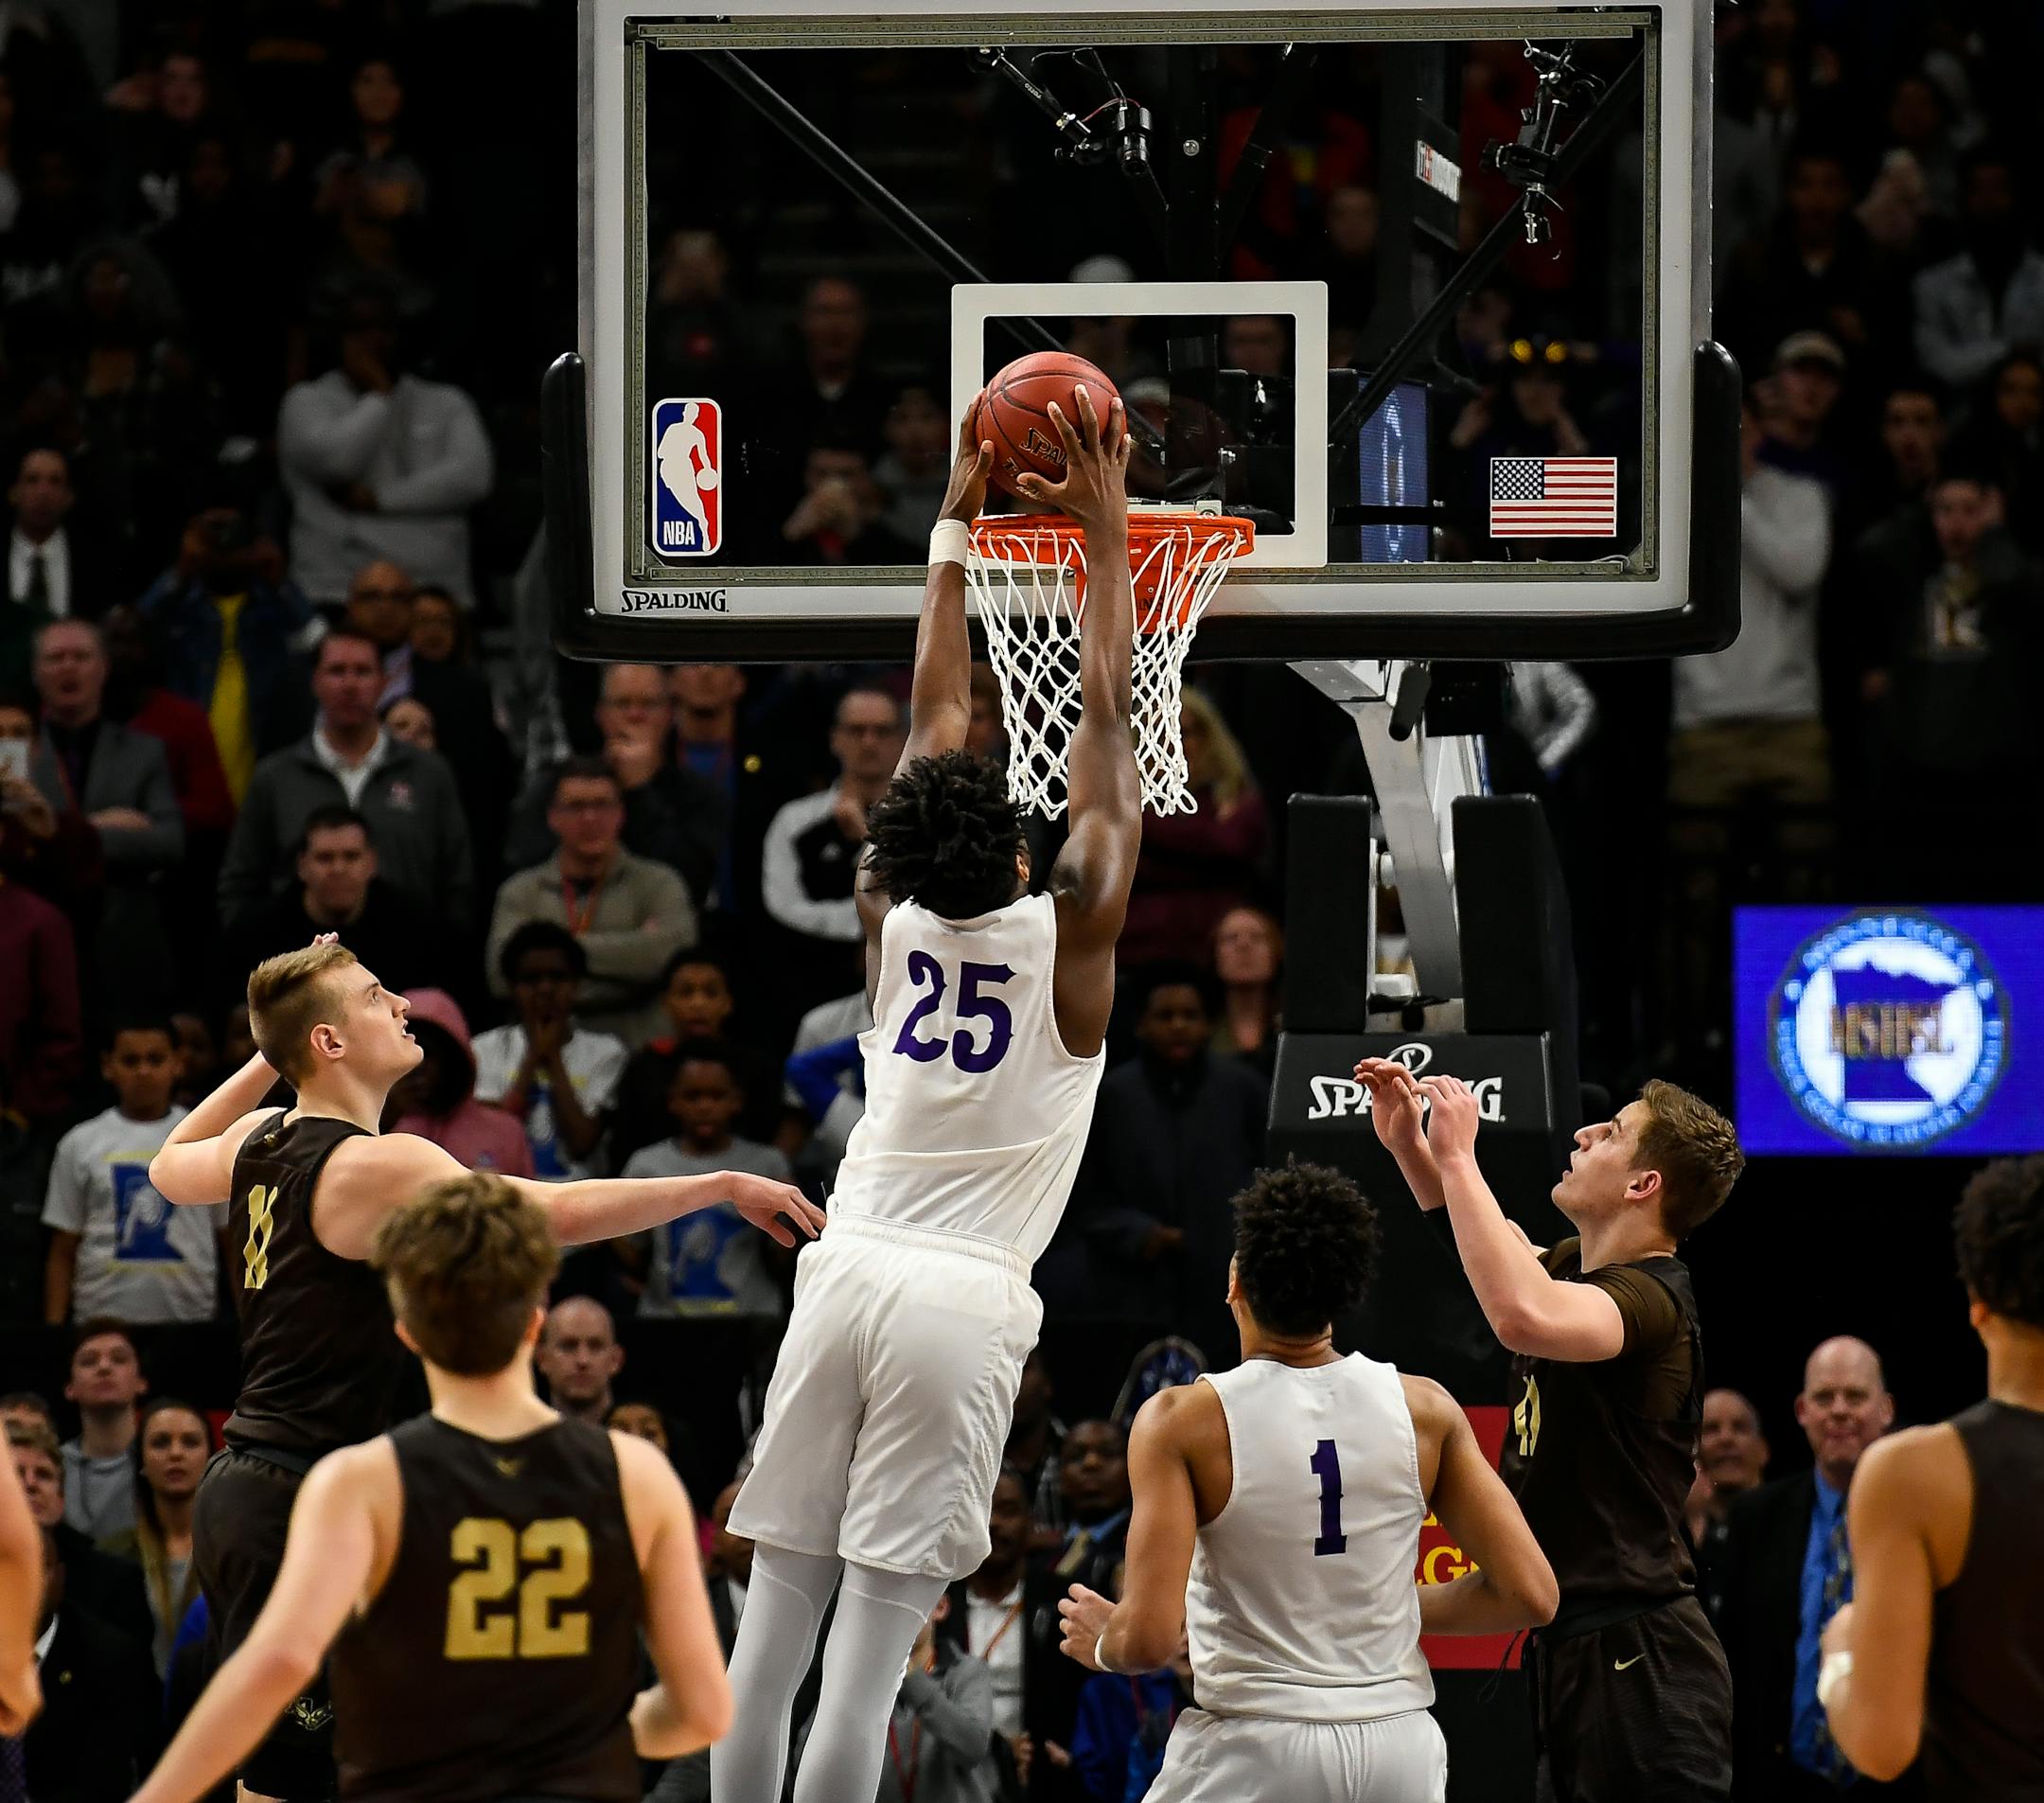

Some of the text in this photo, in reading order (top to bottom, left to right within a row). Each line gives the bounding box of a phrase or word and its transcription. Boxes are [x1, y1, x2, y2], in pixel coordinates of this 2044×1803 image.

[663, 521, 696, 546] NBA
[621, 589, 727, 613] SPALDING
[892, 949, 1017, 1074] 25
[1309, 1438, 1348, 1557] 1
[444, 1516, 591, 1661] 22
